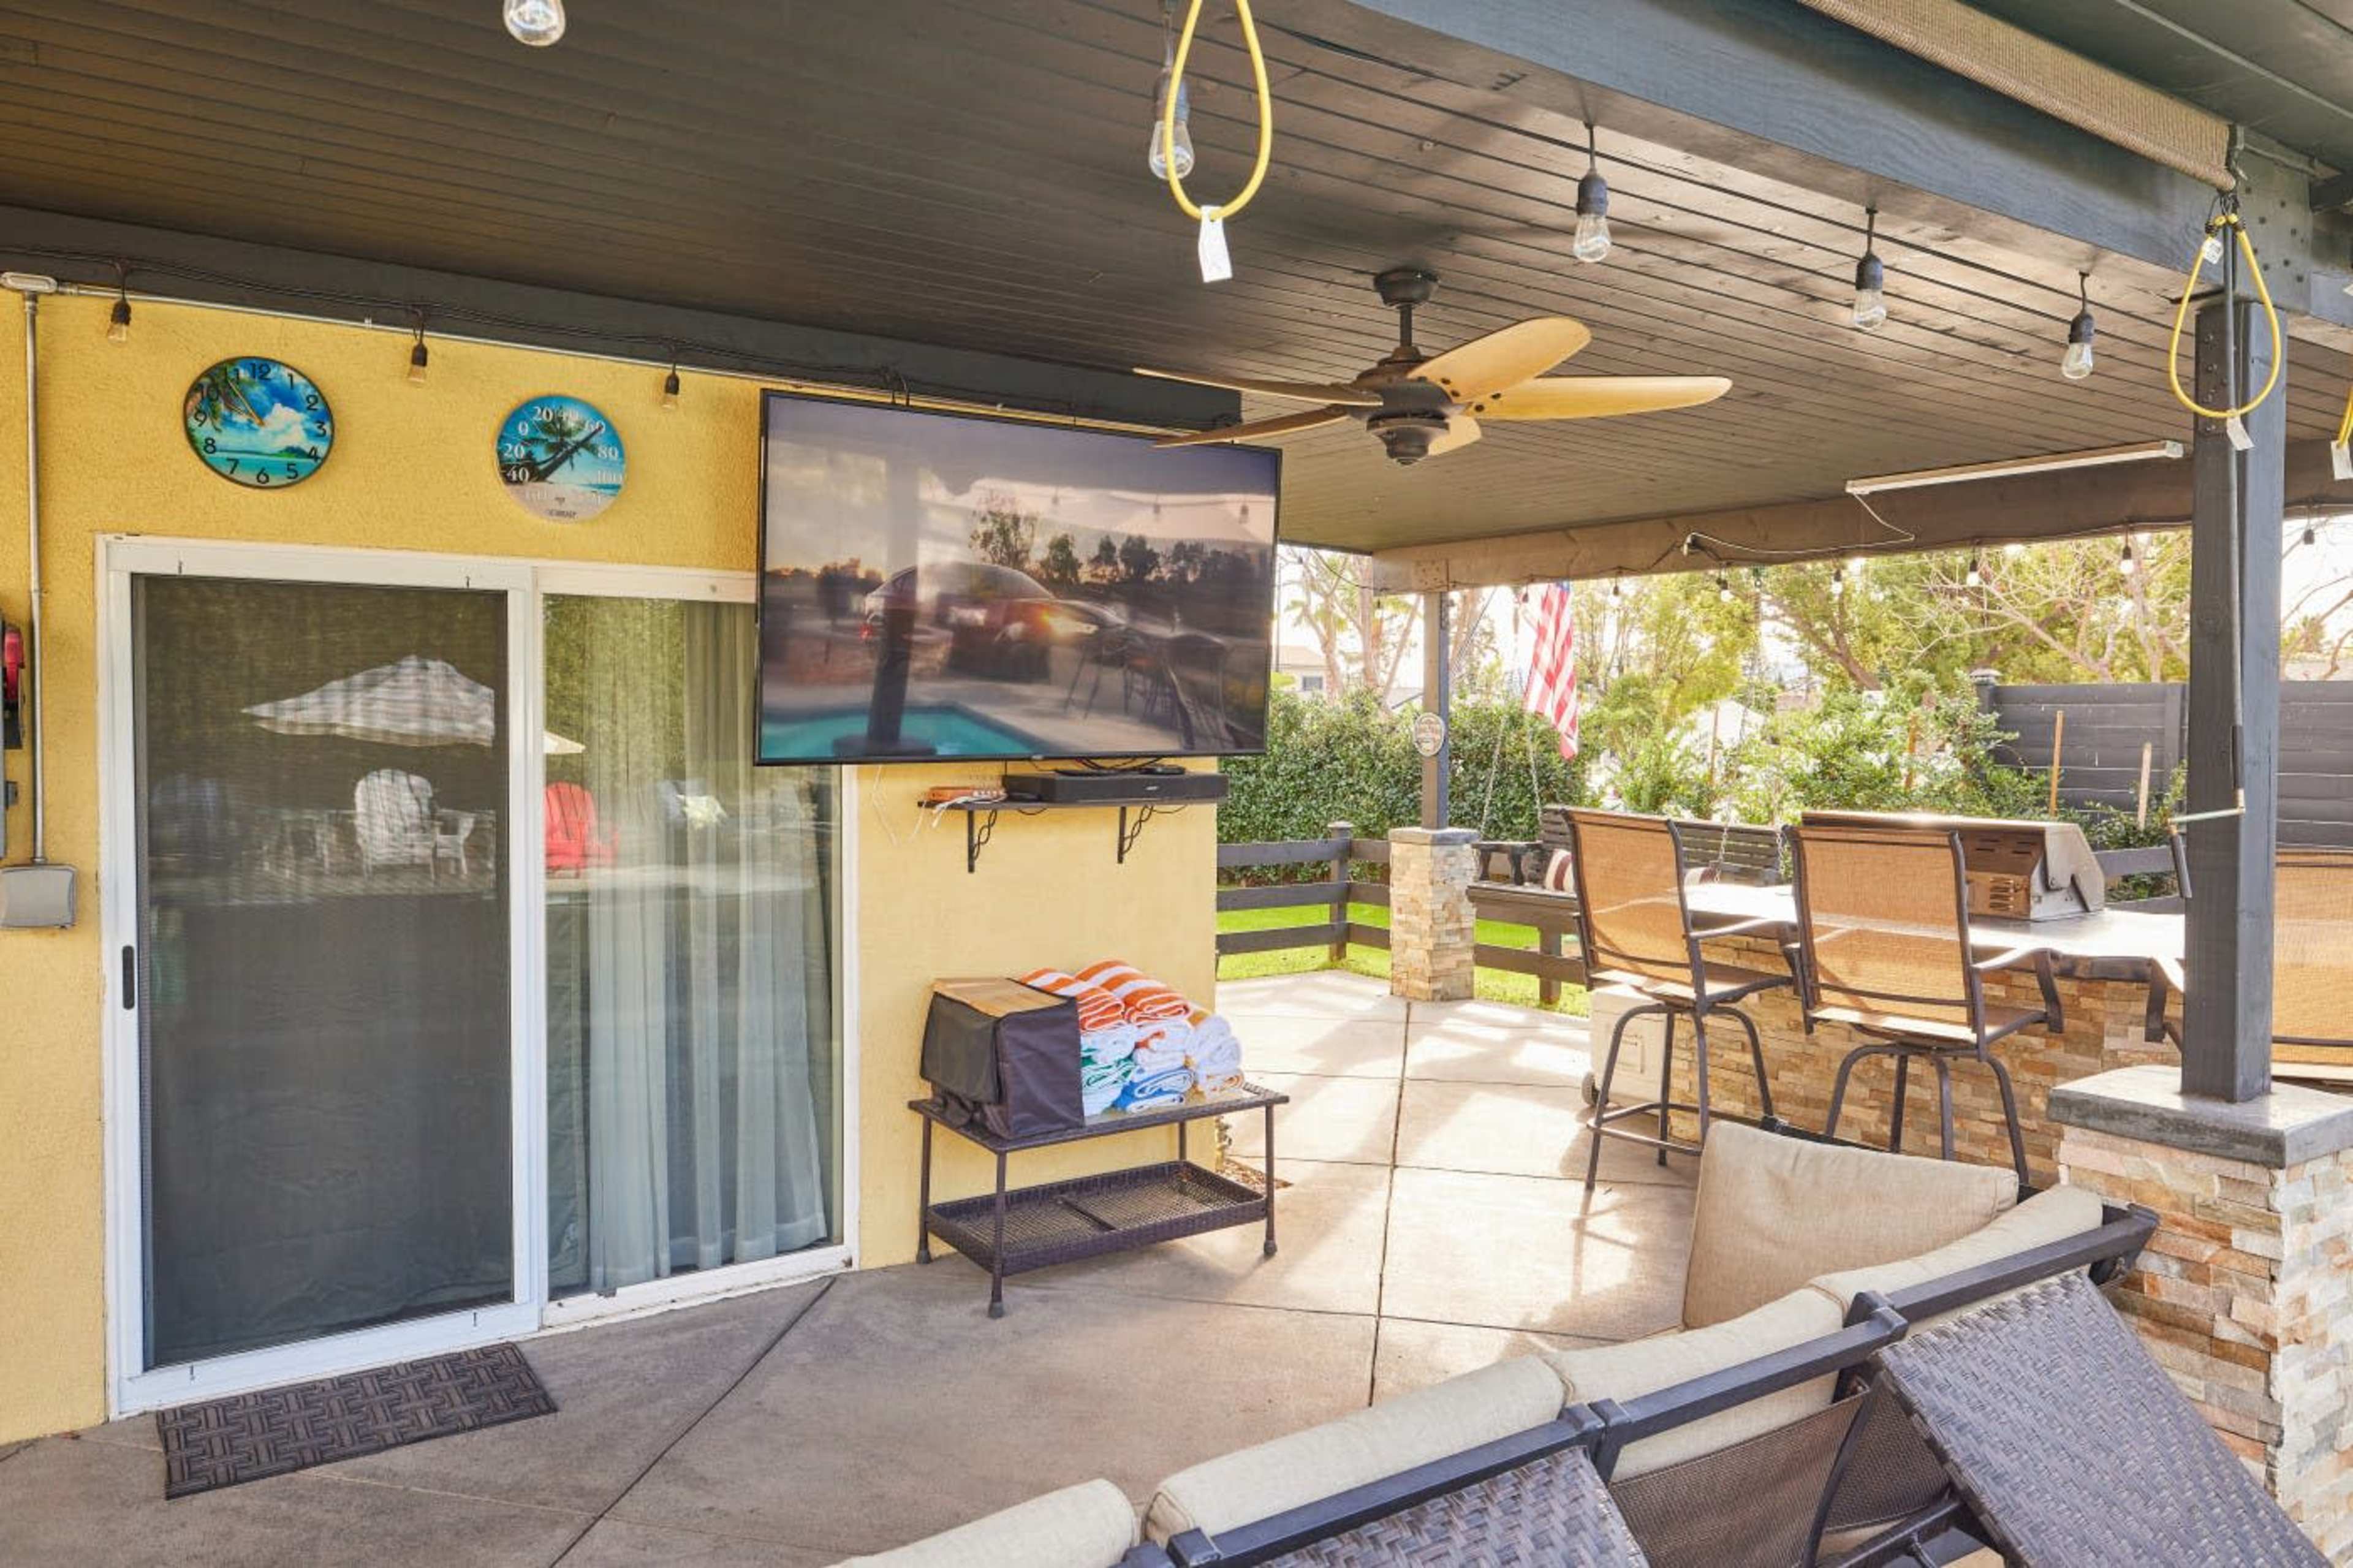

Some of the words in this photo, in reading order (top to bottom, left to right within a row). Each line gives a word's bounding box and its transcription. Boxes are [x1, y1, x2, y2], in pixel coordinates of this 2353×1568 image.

[250, 363, 271, 381] 12
[287, 373, 294, 390] 1
[306, 395, 319, 411] 2
[194, 410, 207, 427] 9
[532, 406, 553, 422] 20
[314, 420, 327, 437] 3
[518, 421, 529, 436] 0
[203, 437, 216, 454] 8
[504, 443, 525, 460] 20
[597, 446, 619, 460] 80
[308, 446, 320, 462] 4
[226, 458, 240, 474] 7
[287, 463, 298, 479] 5
[506, 466, 530, 482] 40
[256, 468, 270, 484] 6
